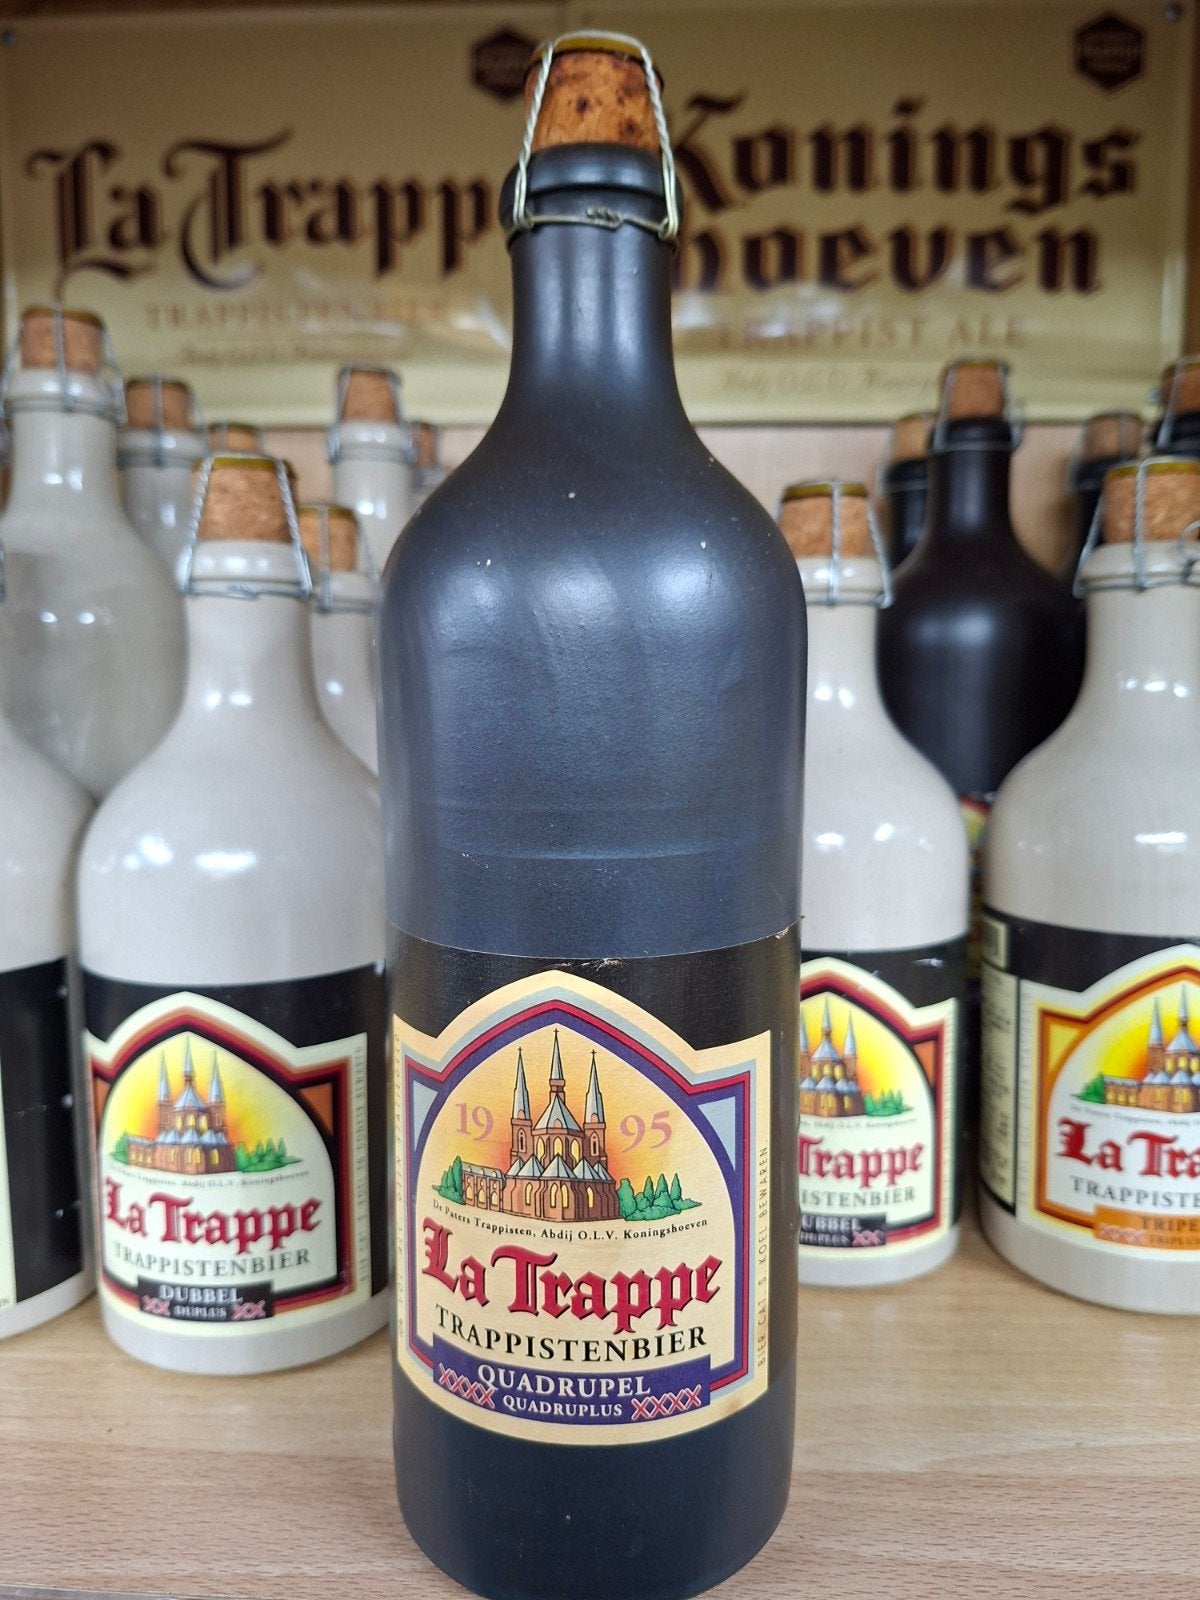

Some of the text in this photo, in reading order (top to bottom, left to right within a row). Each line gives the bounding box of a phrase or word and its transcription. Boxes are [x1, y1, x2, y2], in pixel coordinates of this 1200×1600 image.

[26, 127, 497, 290] La Trapp
[946, 317, 1024, 348] ALE
[455, 1102, 673, 1153] 19 95
[797, 1132, 925, 1188] Trappe
[1056, 1116, 1200, 1178] La Tra
[759, 1140, 768, 1218] BEWAREN.
[801, 1186, 916, 1207] ISTENBIER
[1070, 1175, 1200, 1208] TRAPPISTE
[105, 1176, 323, 1256] La Trappe
[445, 1204, 471, 1224] Paters
[474, 1216, 536, 1238] Trappisten,
[540, 1228, 573, 1243] Abdij
[578, 1229, 618, 1240] O.L.V.
[623, 1219, 708, 1239] Koningshoeven
[801, 1214, 862, 1232] UBBEL
[1141, 1215, 1200, 1232] TRIPE
[114, 1242, 310, 1277] TRAPPISTENBIER
[758, 1225, 768, 1265] KOEL
[159, 1284, 243, 1304] DUBBEL
[422, 1216, 722, 1335] La Trappe
[435, 1303, 708, 1363] TRAPPISTENBIER
[757, 1334, 767, 1367] BIER
[478, 1363, 651, 1399] QUADRUPEL
[502, 1395, 623, 1417] QUADRUPLUS
